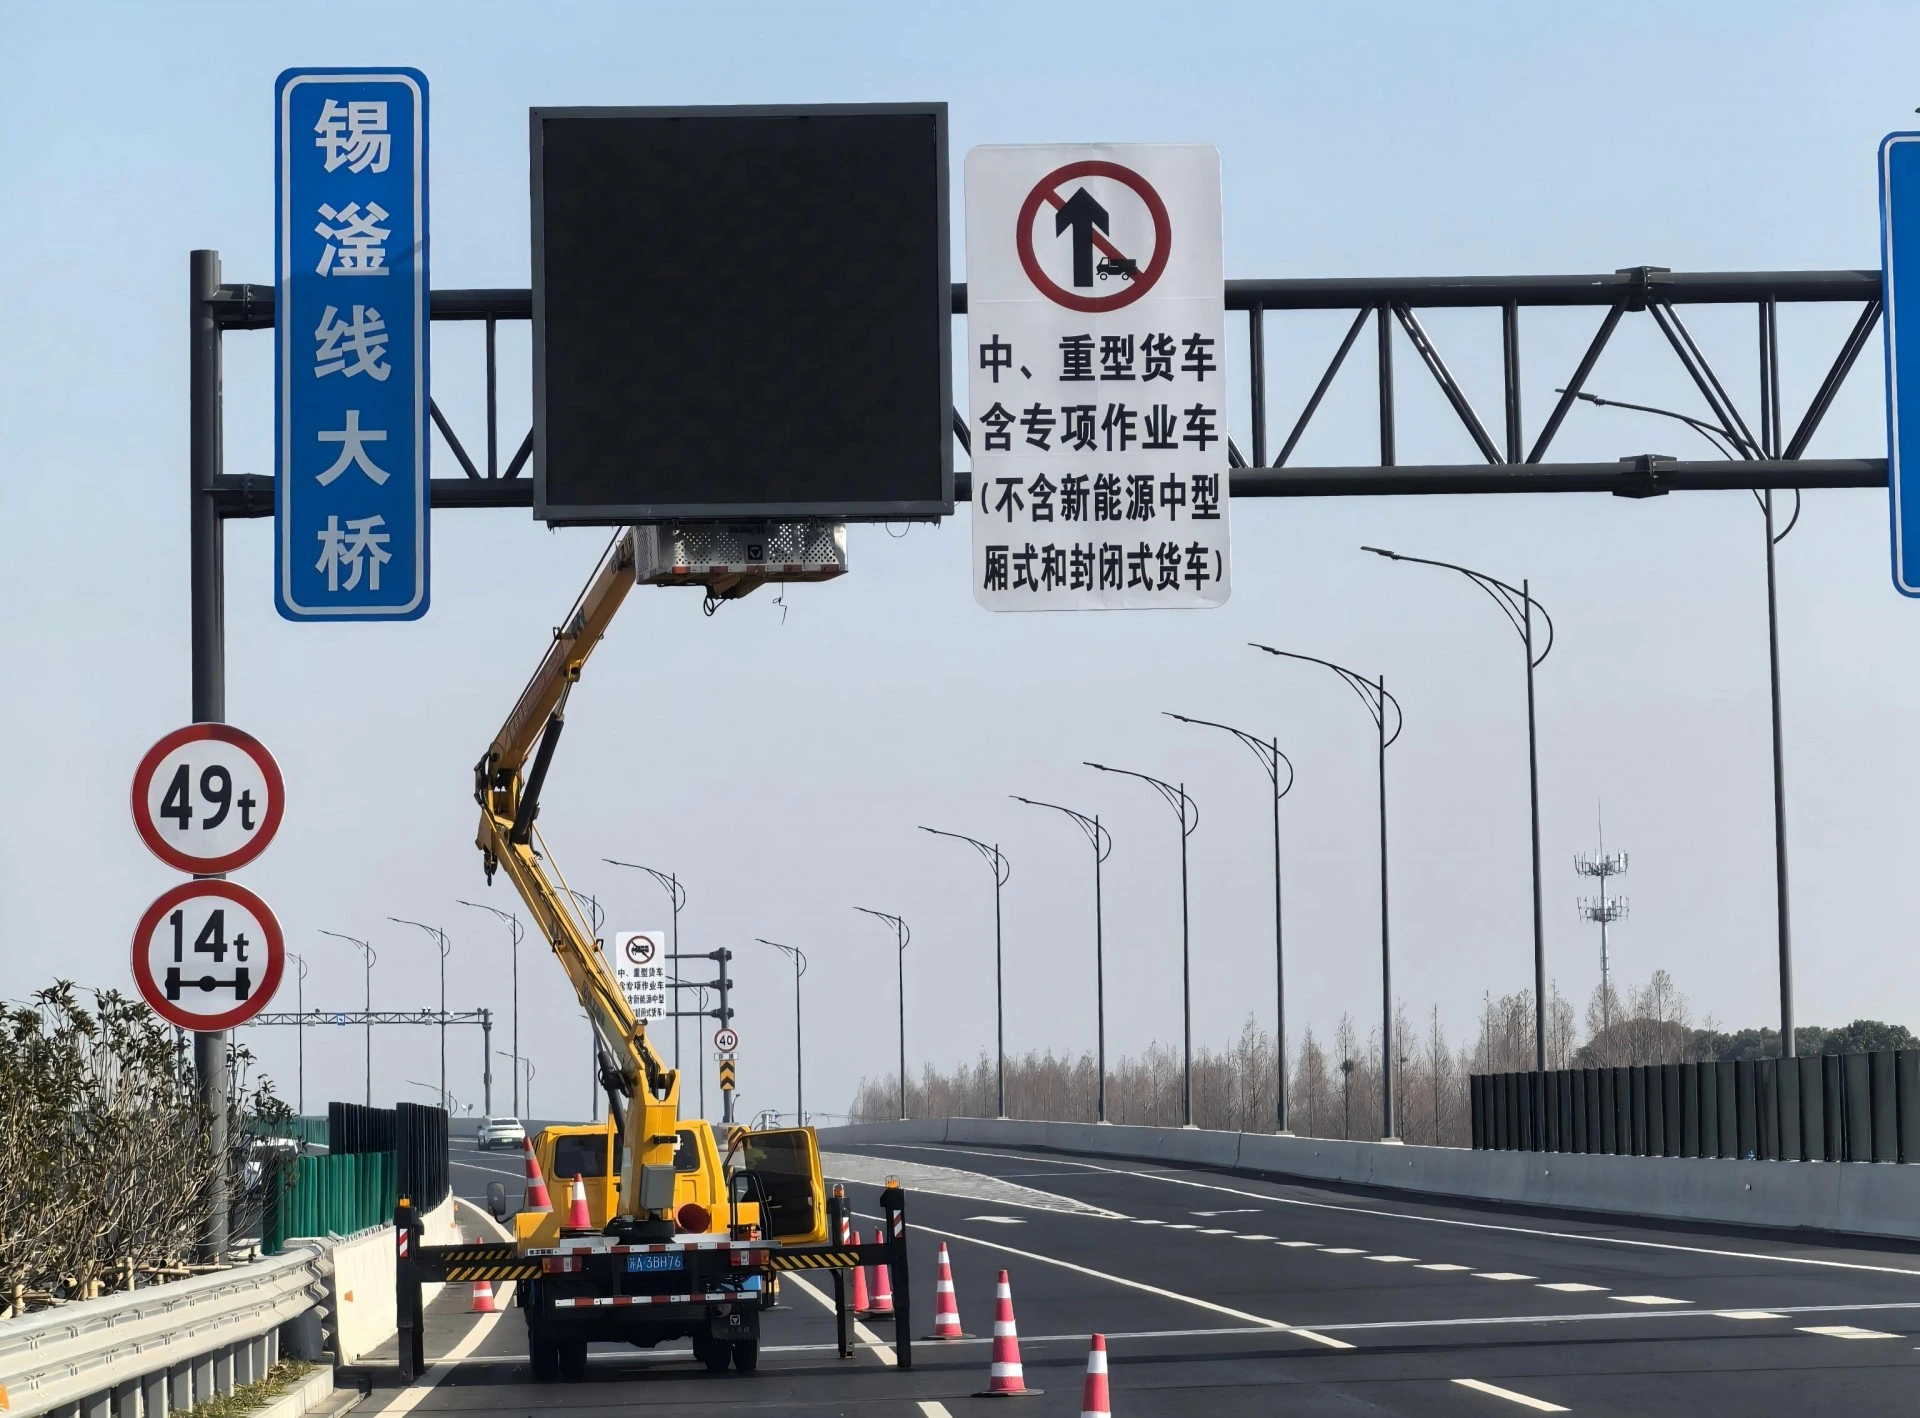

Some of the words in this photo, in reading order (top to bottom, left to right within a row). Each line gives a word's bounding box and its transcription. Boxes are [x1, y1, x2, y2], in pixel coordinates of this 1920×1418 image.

[314, 99, 392, 592] 锡滏线大桥
[980, 332, 1217, 383] 中、重型货车
[979, 402, 1219, 451] 含专项作业车
[981, 472, 1221, 522] (不含新能源中型
[983, 541, 1223, 592] 厢式和封闭式货车)
[719, 1035, 734, 1046] 40
